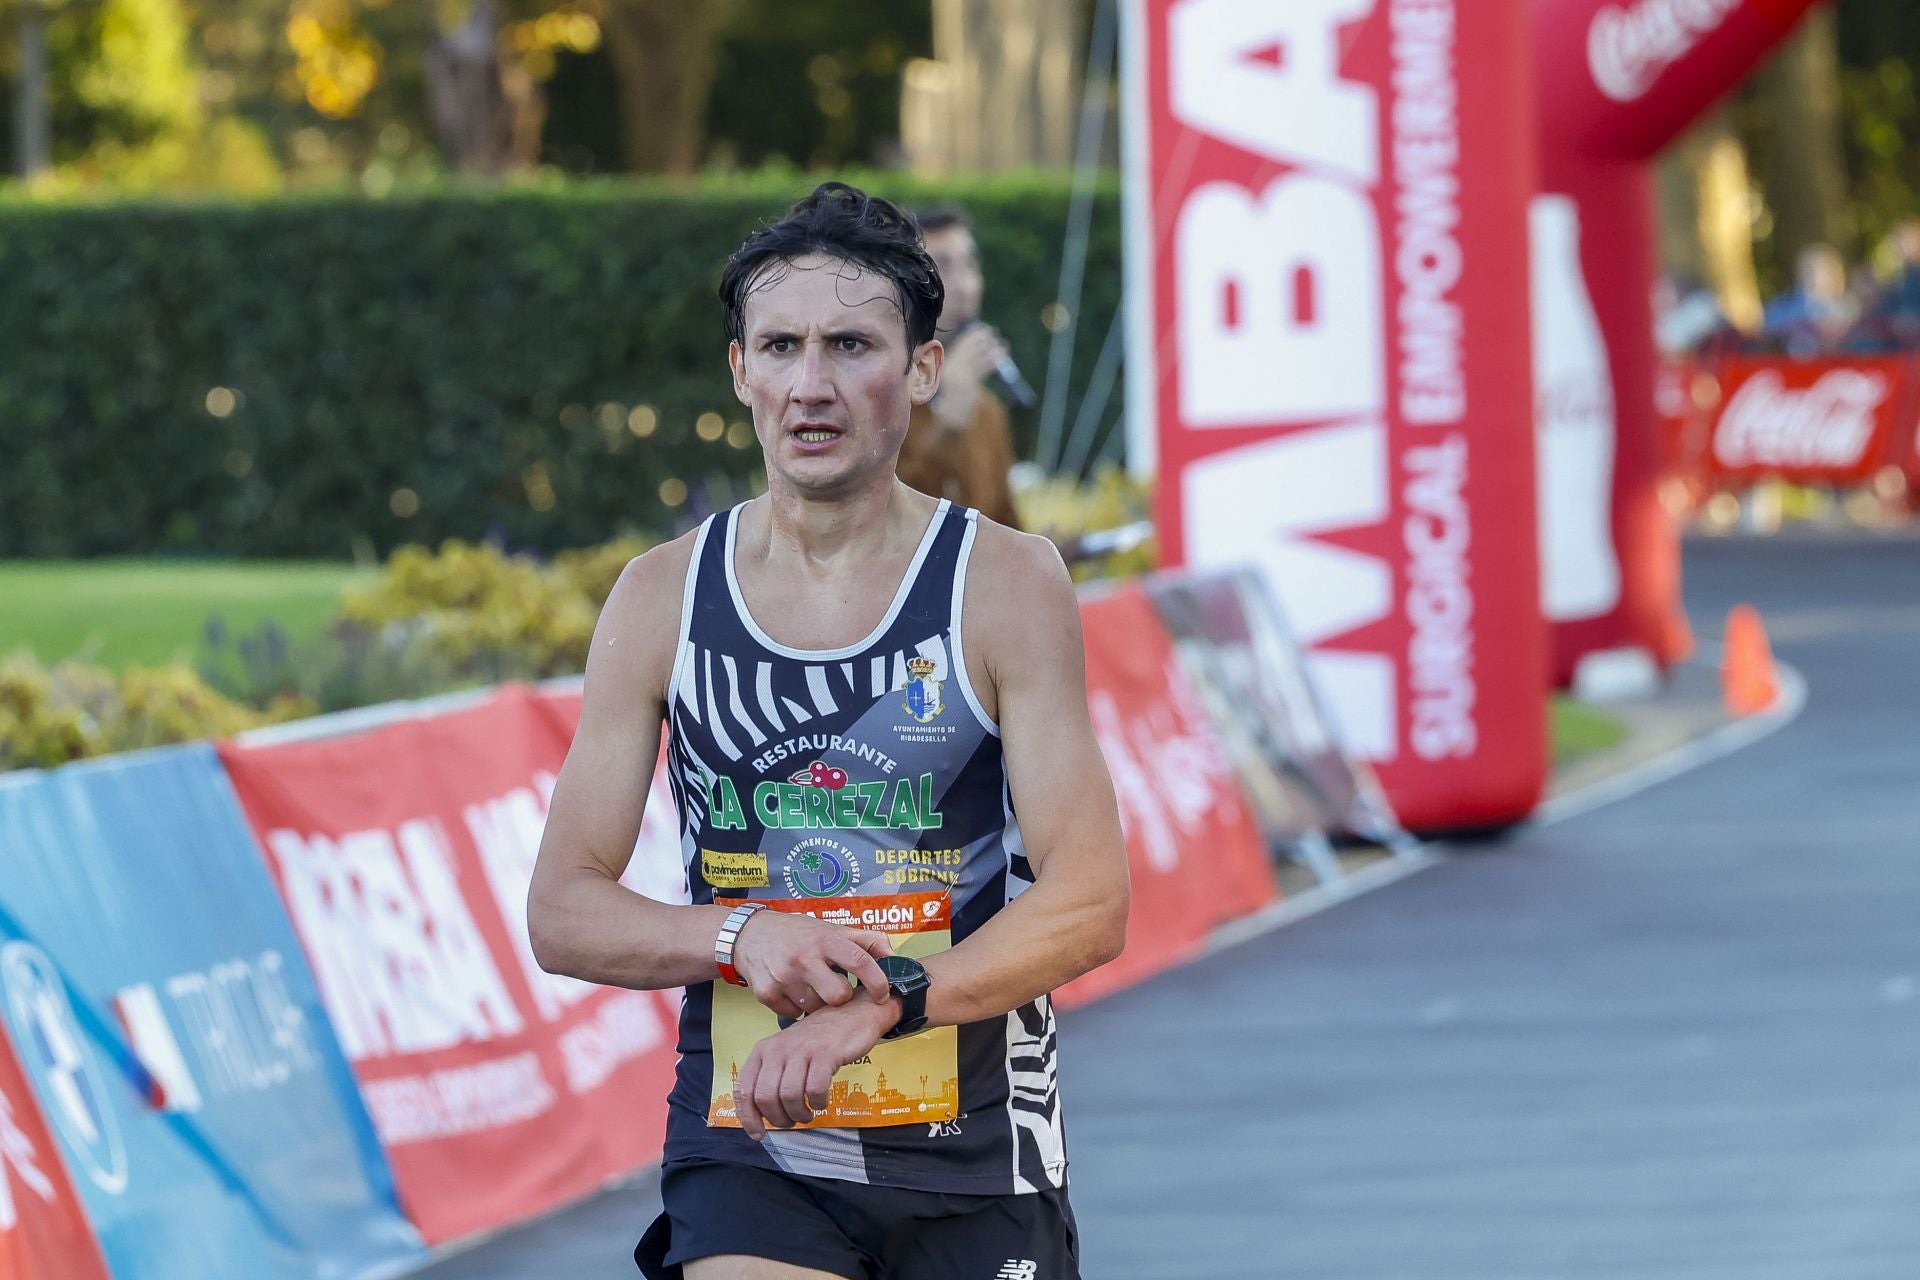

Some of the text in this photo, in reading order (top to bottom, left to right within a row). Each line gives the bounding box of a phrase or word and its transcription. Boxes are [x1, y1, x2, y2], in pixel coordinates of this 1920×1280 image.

[1388, 0, 1477, 760] SURGICAL EMPOWERME
[893, 725, 945, 733] AYUNTAMIENTO
[752, 734, 897, 774] RESTAURANTE
[697, 764, 943, 830] LA CEREZAL
[787, 837, 839, 862] PAVIMENTOS
[840, 846, 860, 883] VETUSTA
[875, 848, 961, 865] DEPORTES
[822, 908, 850, 918] media
[862, 904, 914, 924] GIJÓN
[871, 923, 899, 931] OCTUBRE
